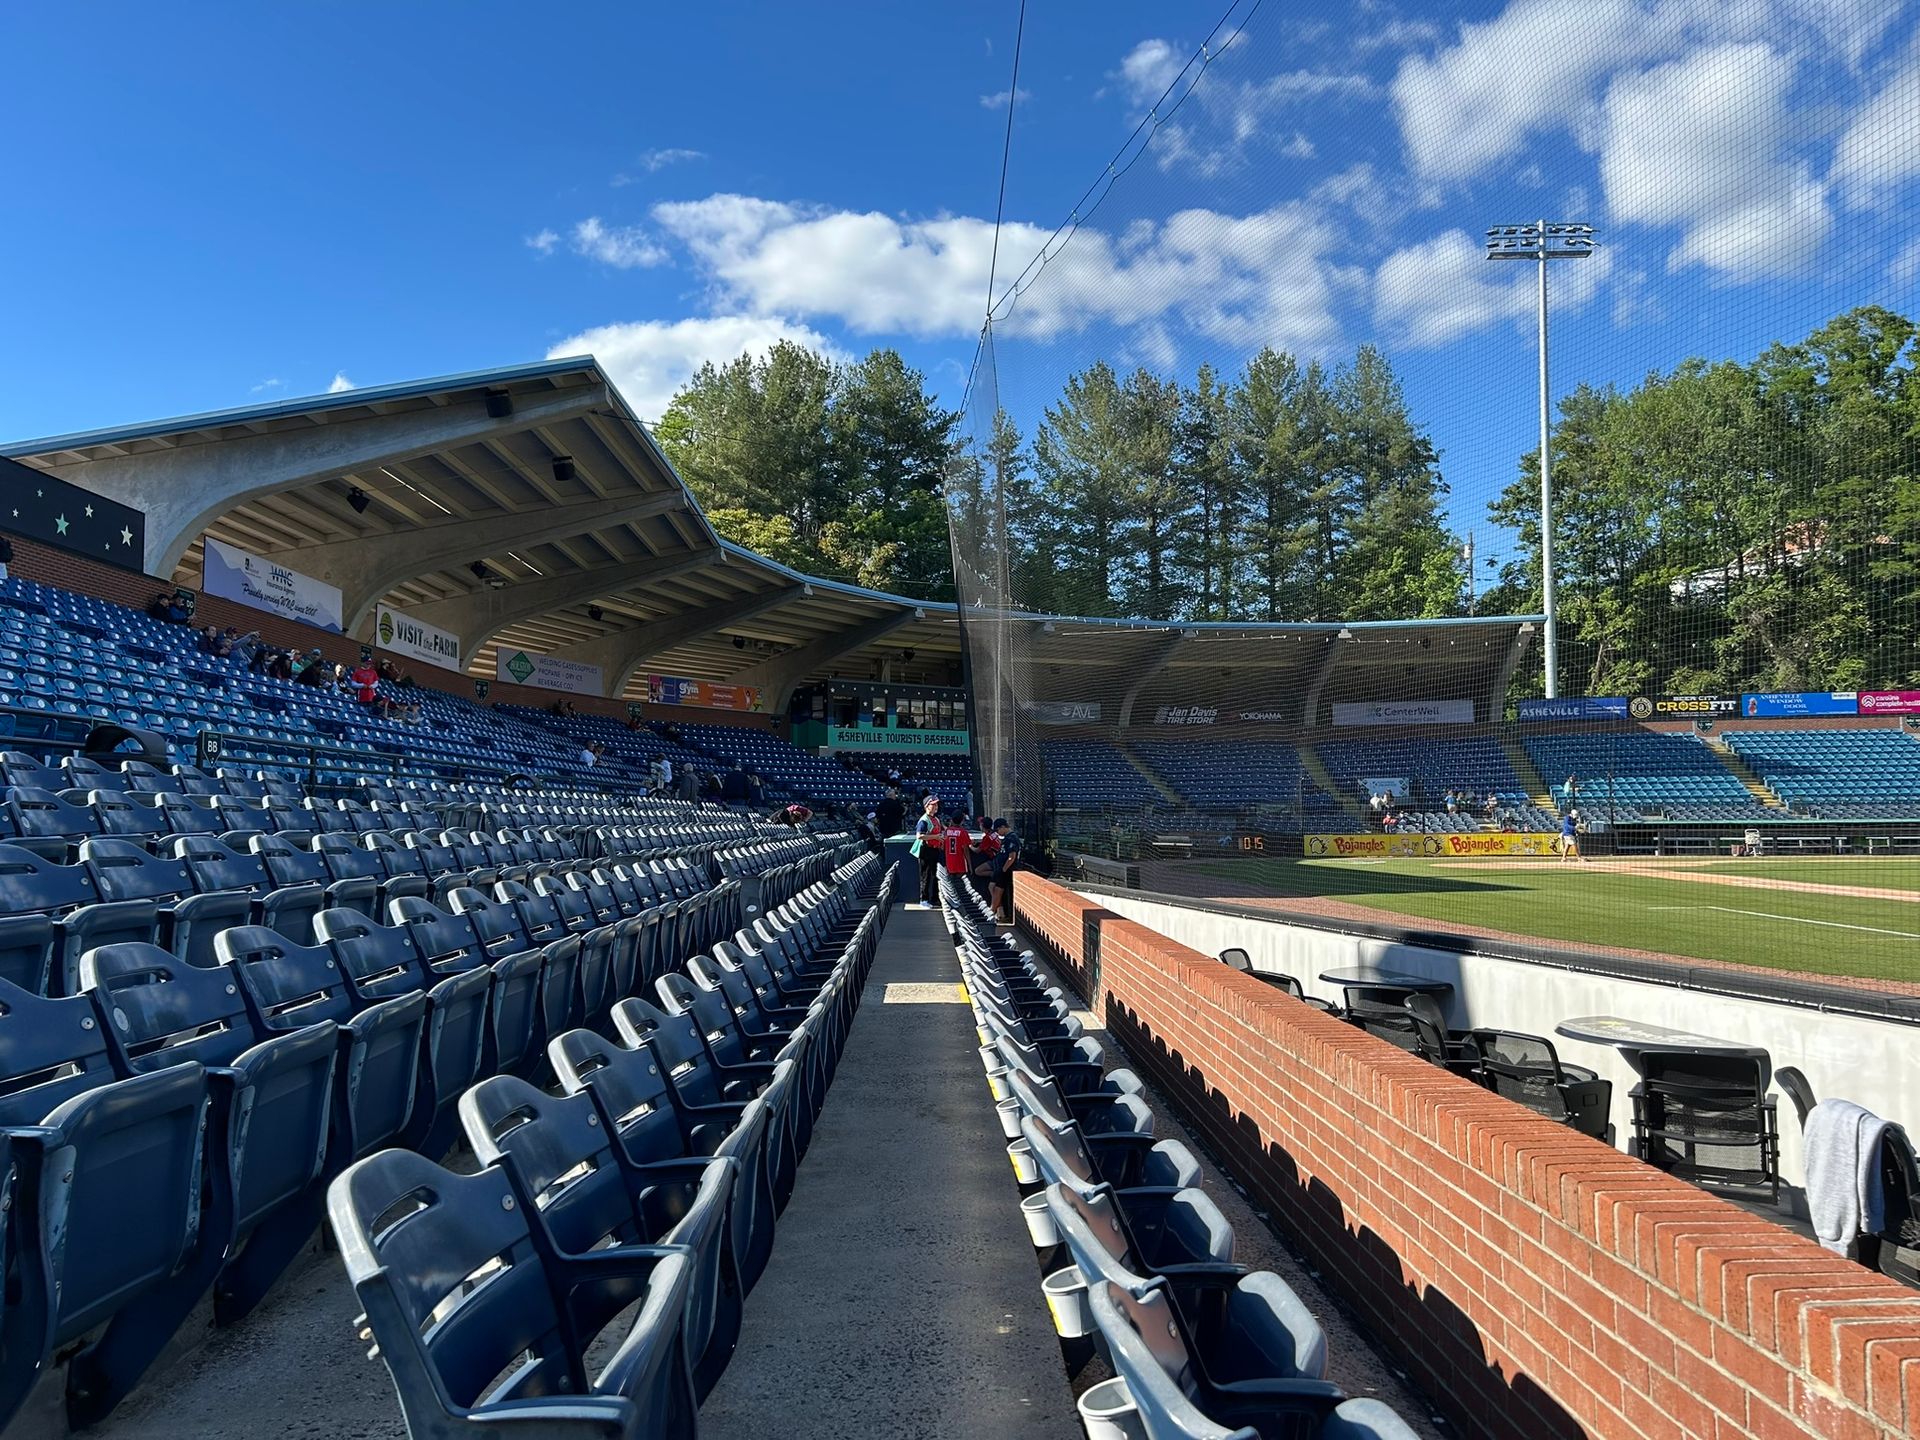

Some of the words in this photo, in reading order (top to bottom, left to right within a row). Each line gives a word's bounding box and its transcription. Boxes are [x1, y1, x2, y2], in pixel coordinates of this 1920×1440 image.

[269, 564, 294, 587] WNC
[241, 583, 263, 601] Proudly
[396, 619, 424, 647] VISIT
[423, 636, 433, 651] the
[433, 633, 458, 659] FARM
[539, 657, 561, 668] WELDING
[538, 667, 561, 678] PROPANE
[678, 681, 699, 695] gym
[1071, 704, 1096, 719] AVL
[1168, 706, 1188, 717] Jan
[1190, 706, 1218, 717] Davis
[1384, 706, 1440, 717] CenterWell
[1520, 707, 1580, 717] ASHEVILLE
[1656, 700, 1737, 712] CROSSFIT
[1167, 716, 1185, 724] TIRE
[1186, 716, 1216, 724] STORE
[837, 731, 883, 743] ASHEVILLE
[885, 733, 921, 744] TOURISTS
[924, 734, 965, 746] BASEBALL
[1333, 836, 1386, 854] Bojangles
[1449, 836, 1505, 854] Bojangles
